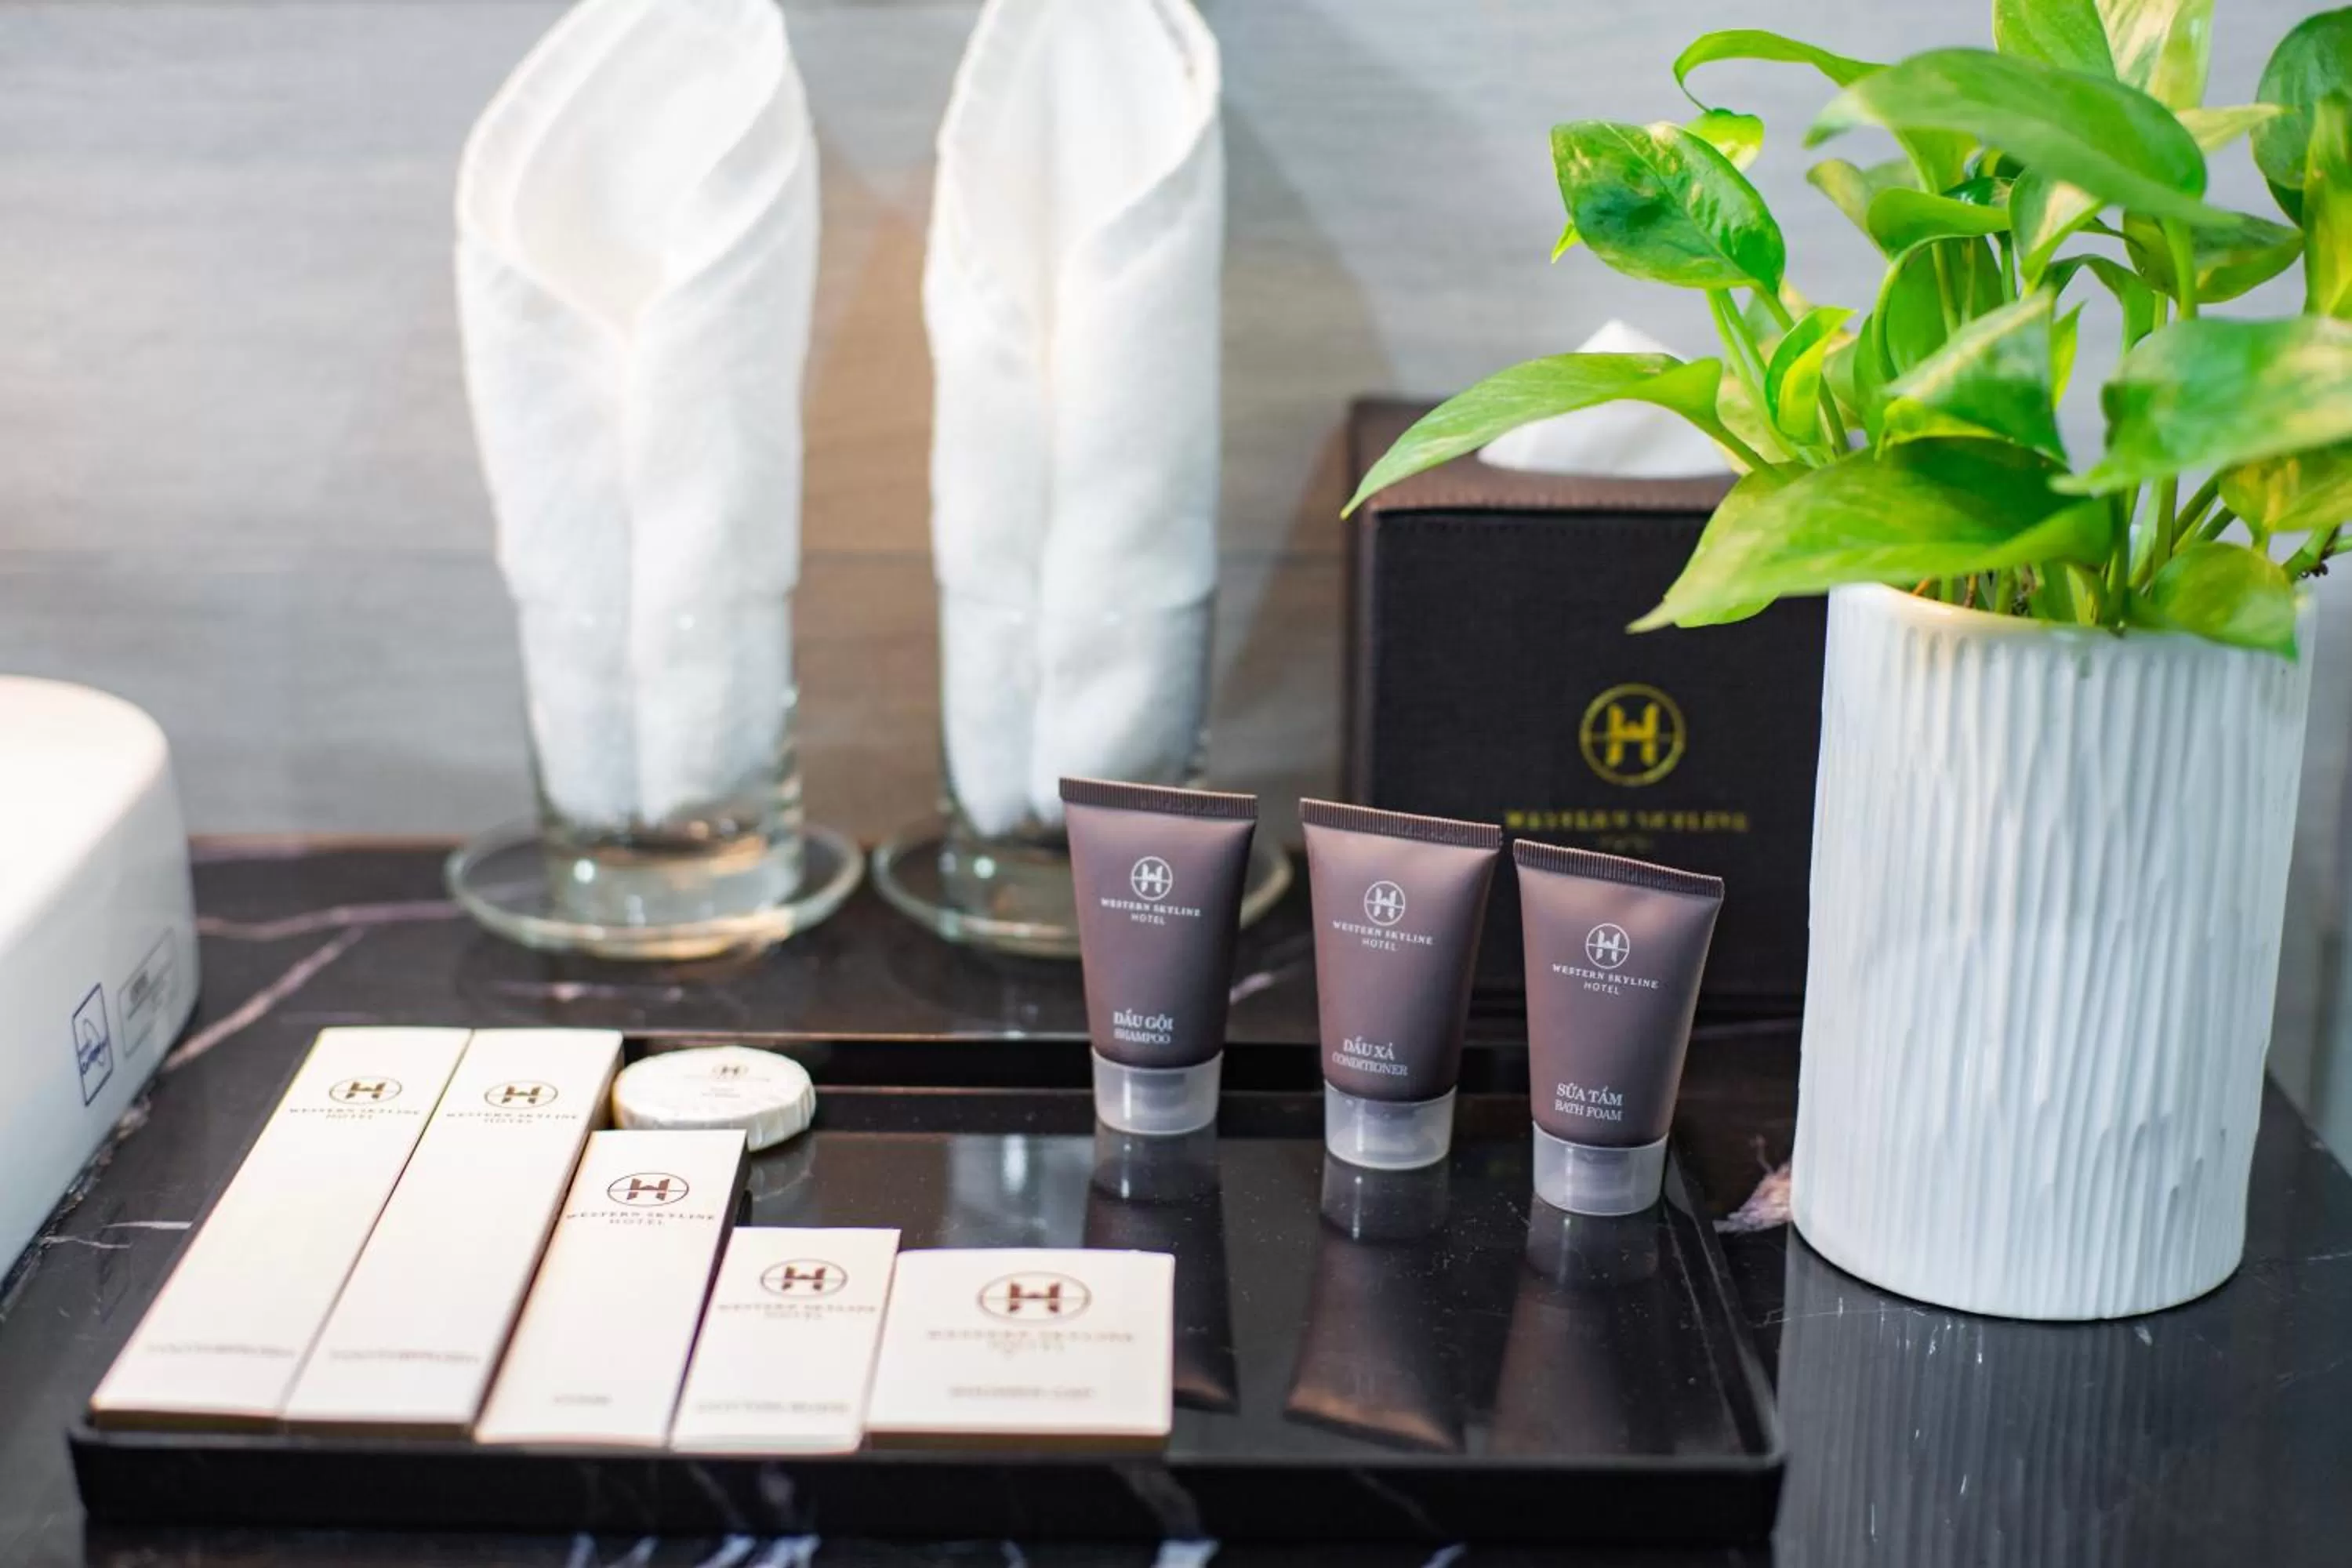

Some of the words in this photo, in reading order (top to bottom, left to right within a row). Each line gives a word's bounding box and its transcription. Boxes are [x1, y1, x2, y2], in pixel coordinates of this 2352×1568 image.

[1100, 898, 1150, 912] WESTERN
[1153, 904, 1202, 917] SKYLINE
[1131, 913, 1167, 926] HOTEL
[1332, 920, 1382, 937] WESTERN
[1385, 928, 1434, 946] SKYLINE
[1362, 937, 1397, 952] HOTEL
[1552, 964, 1605, 980] WESTERN
[1608, 972, 1660, 989] SKYLINE
[1583, 981, 1620, 996] HOTEL
[1113, 1028, 1171, 1045] SHAMPOO
[1332, 1051, 1409, 1076] CONDITIONER
[1555, 1099, 1584, 1117] BATH
[1586, 1105, 1623, 1122] FOAM
